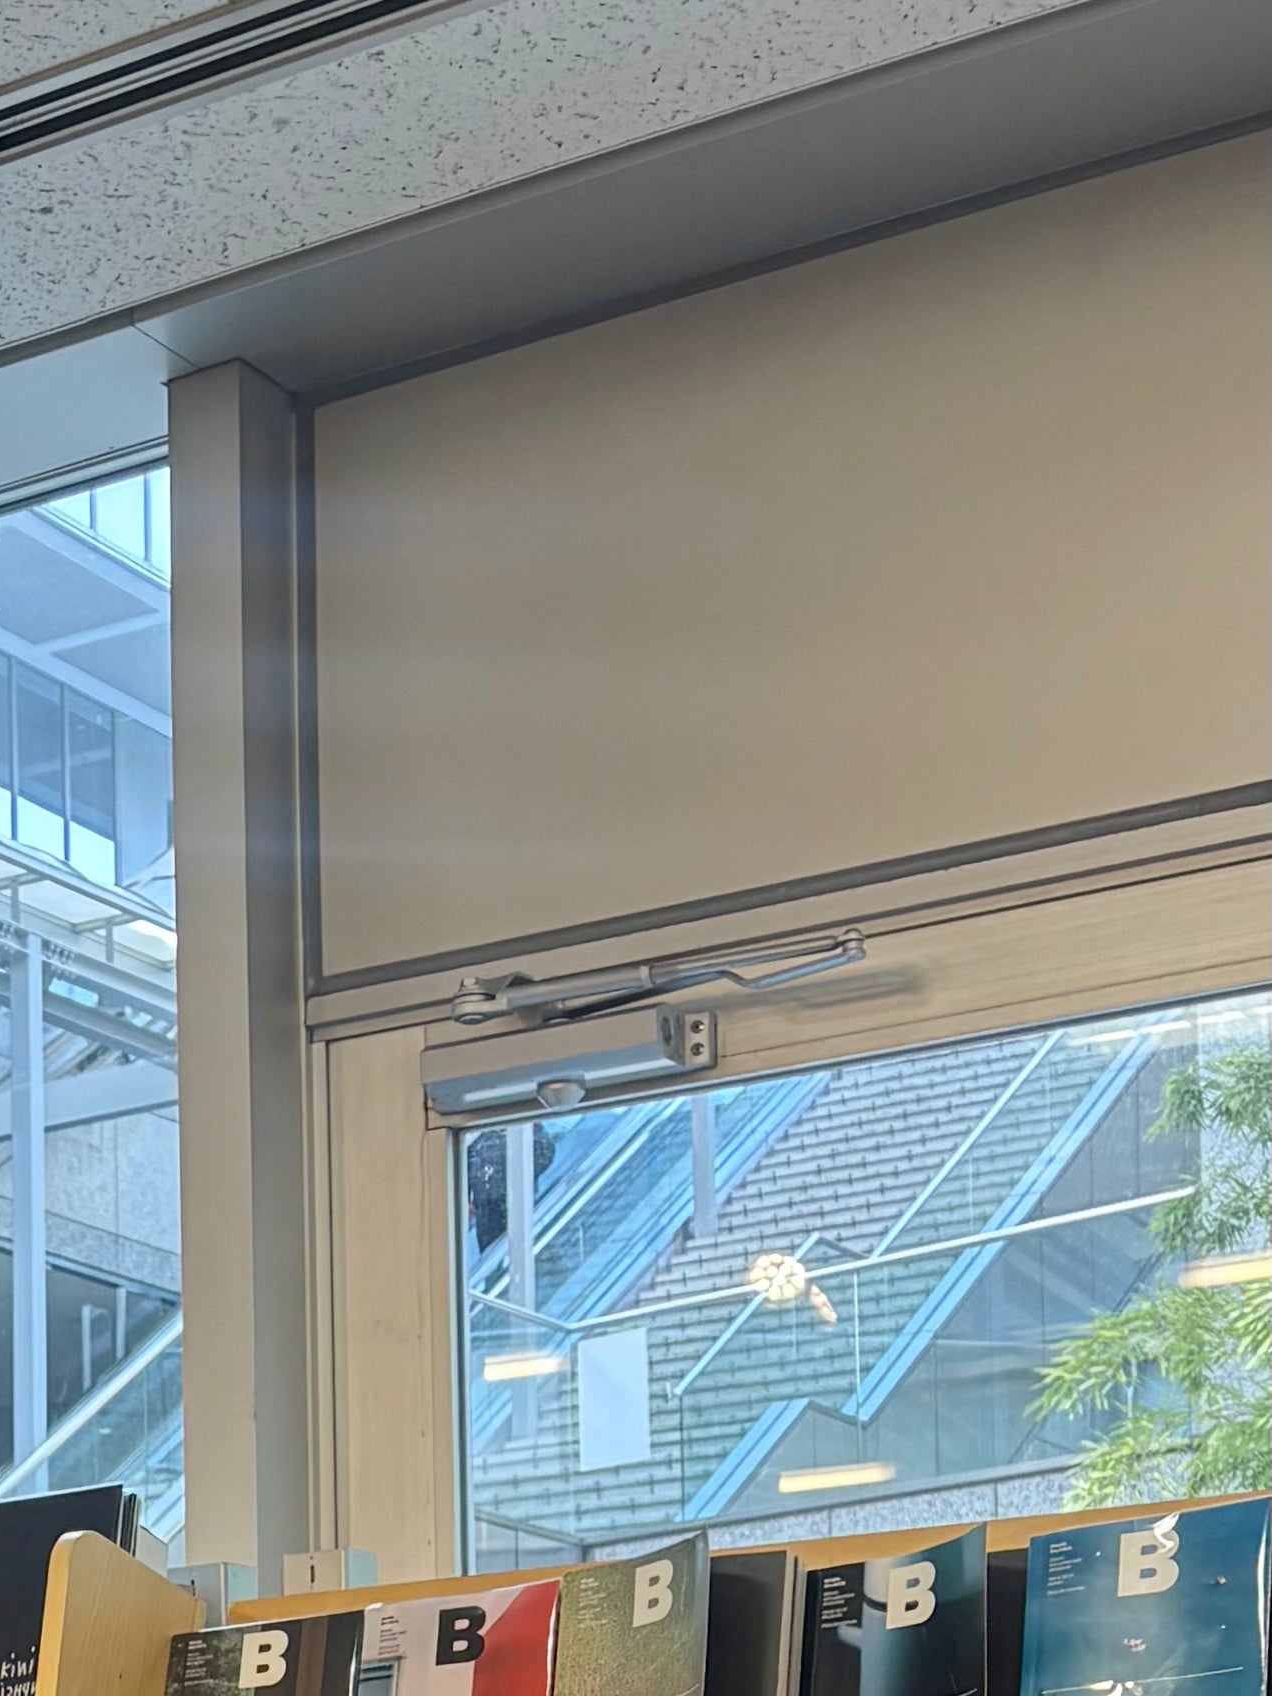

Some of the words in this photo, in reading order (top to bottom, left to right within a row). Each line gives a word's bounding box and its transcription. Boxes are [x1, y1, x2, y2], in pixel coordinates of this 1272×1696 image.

[632, 1559, 674, 1628] B
[886, 1560, 937, 1630] B
[1117, 1528, 1181, 1598] B
[238, 1629, 290, 1690] B
[435, 1605, 487, 1666] B
